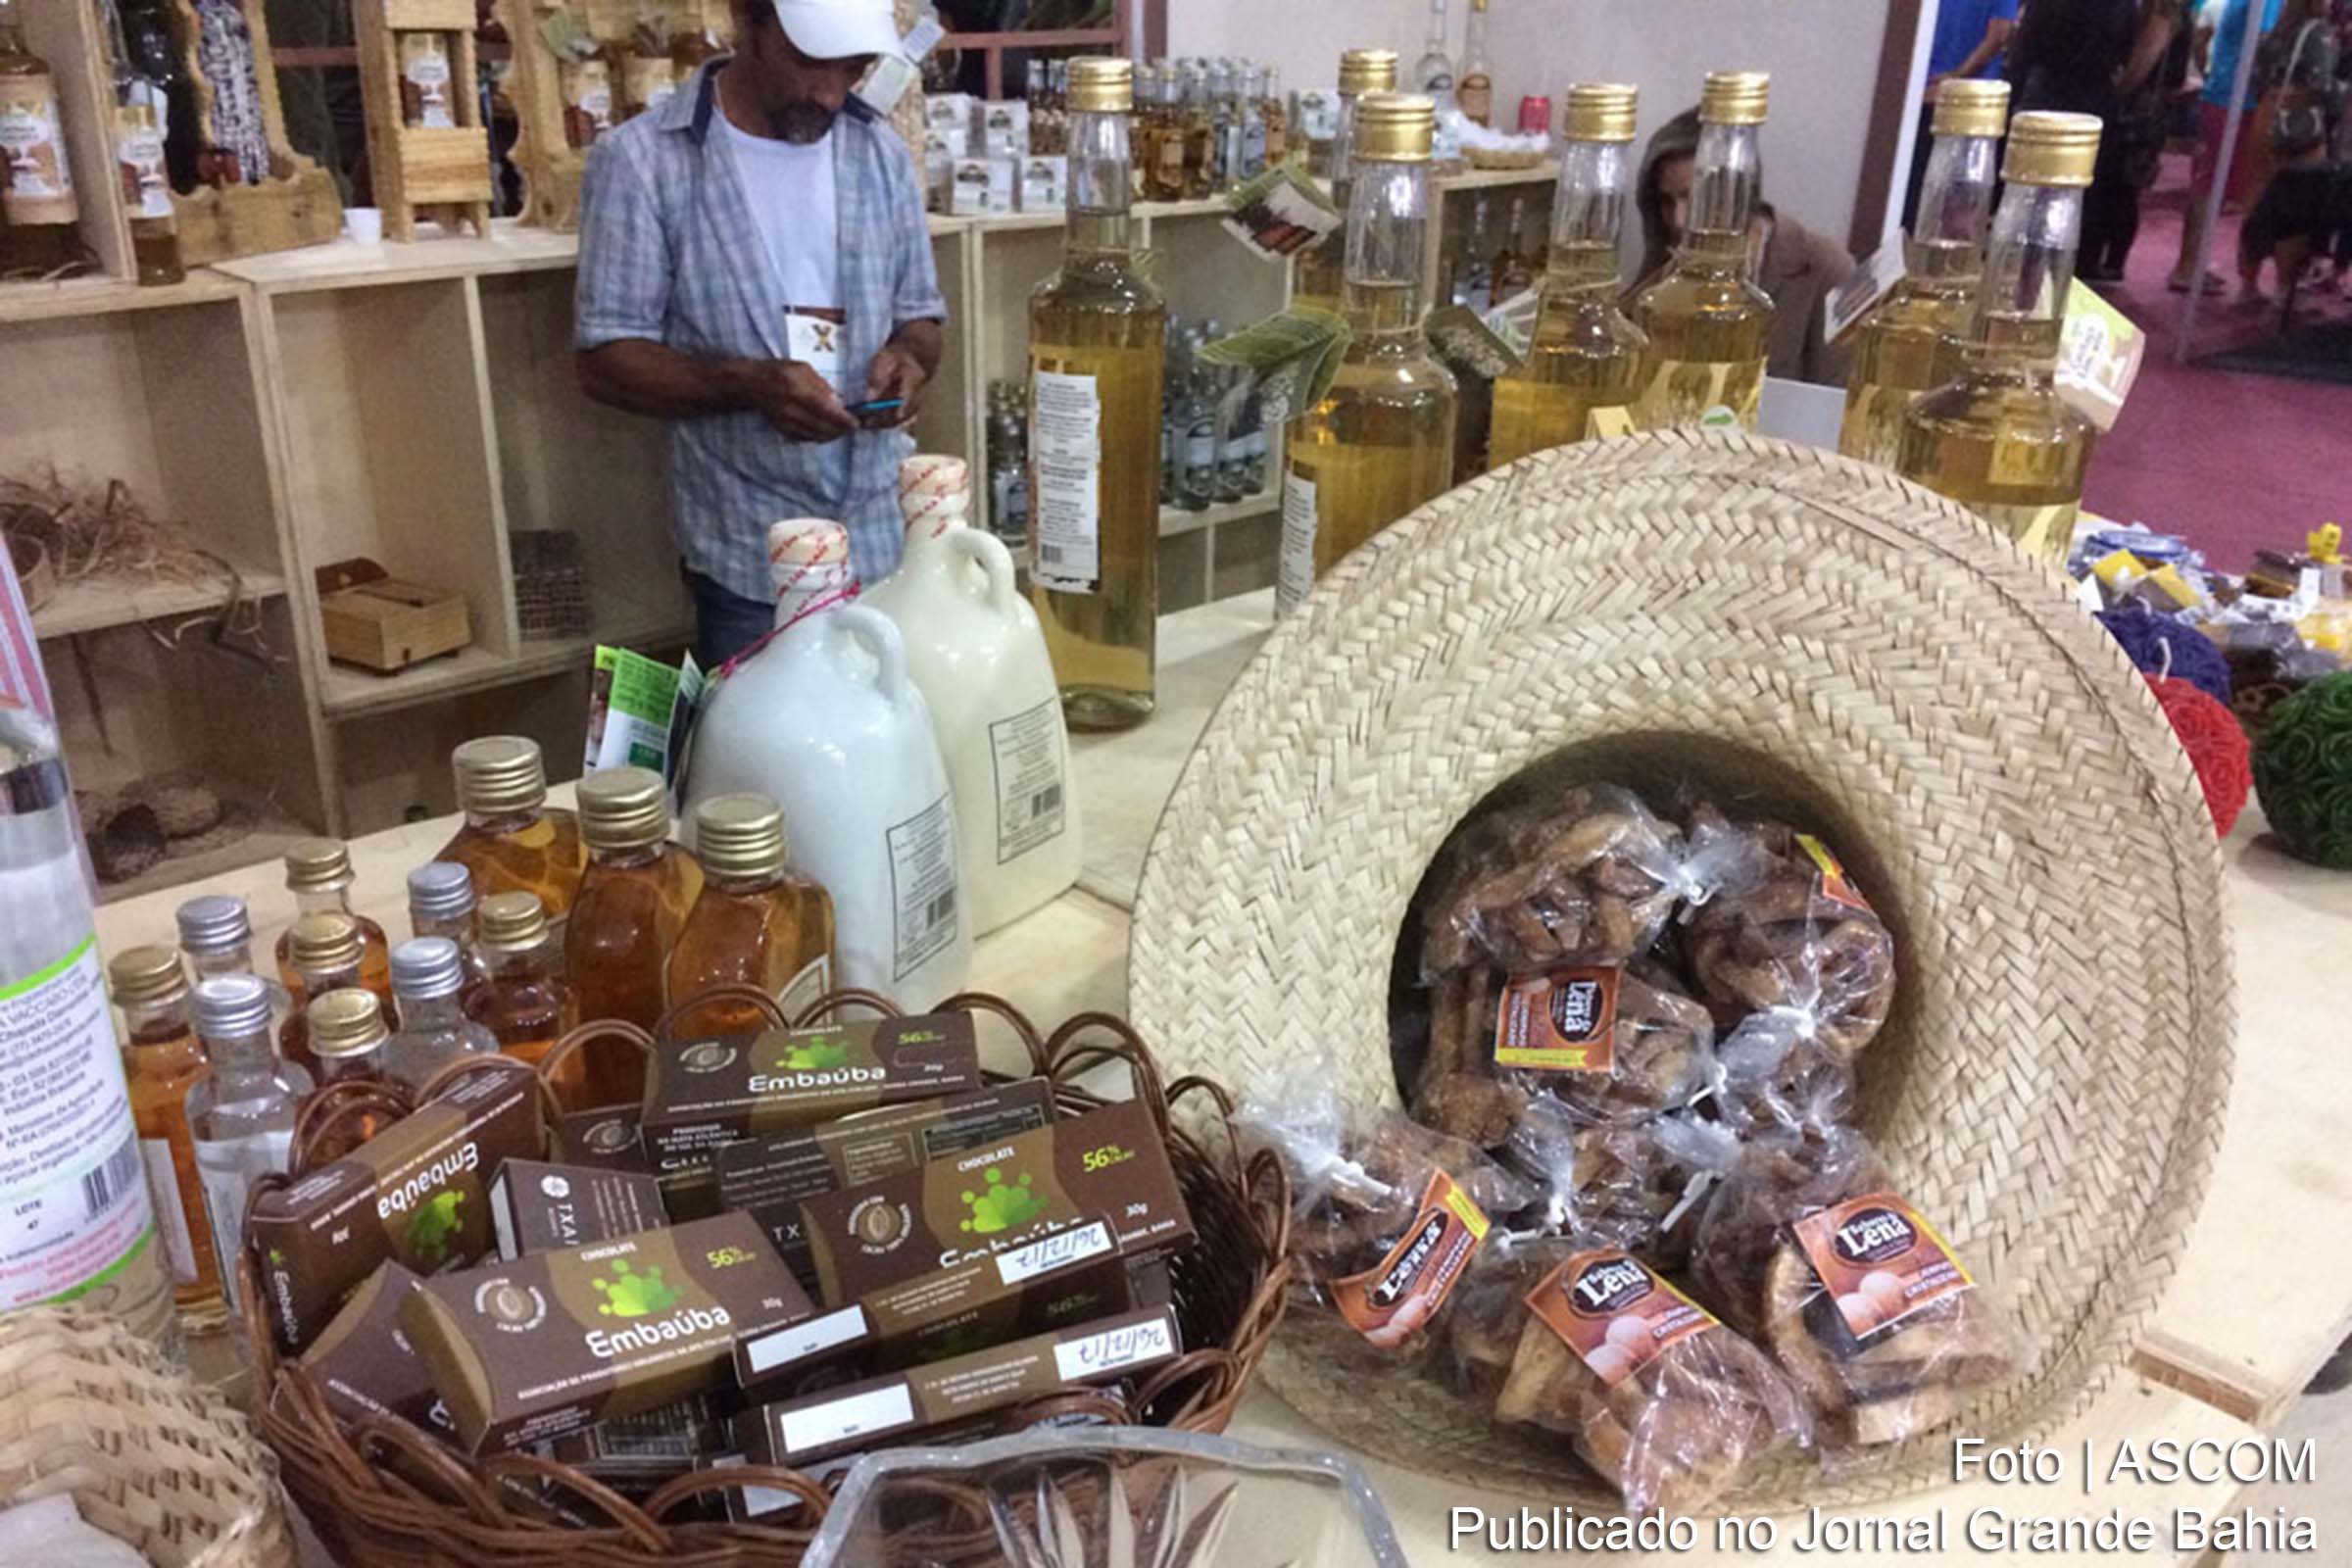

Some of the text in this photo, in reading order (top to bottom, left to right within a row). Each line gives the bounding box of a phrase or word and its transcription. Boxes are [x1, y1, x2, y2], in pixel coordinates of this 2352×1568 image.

[1564, 982, 1597, 1033] Lena
[748, 1065, 887, 1093] Embaúba
[957, 1145, 1016, 1173] CHOCOLATE
[377, 1142, 479, 1219] Embaúba
[1837, 1220, 1911, 1256] Lena
[1574, 1264, 1648, 1306] Lena
[585, 1306, 731, 1358] Embaúba
